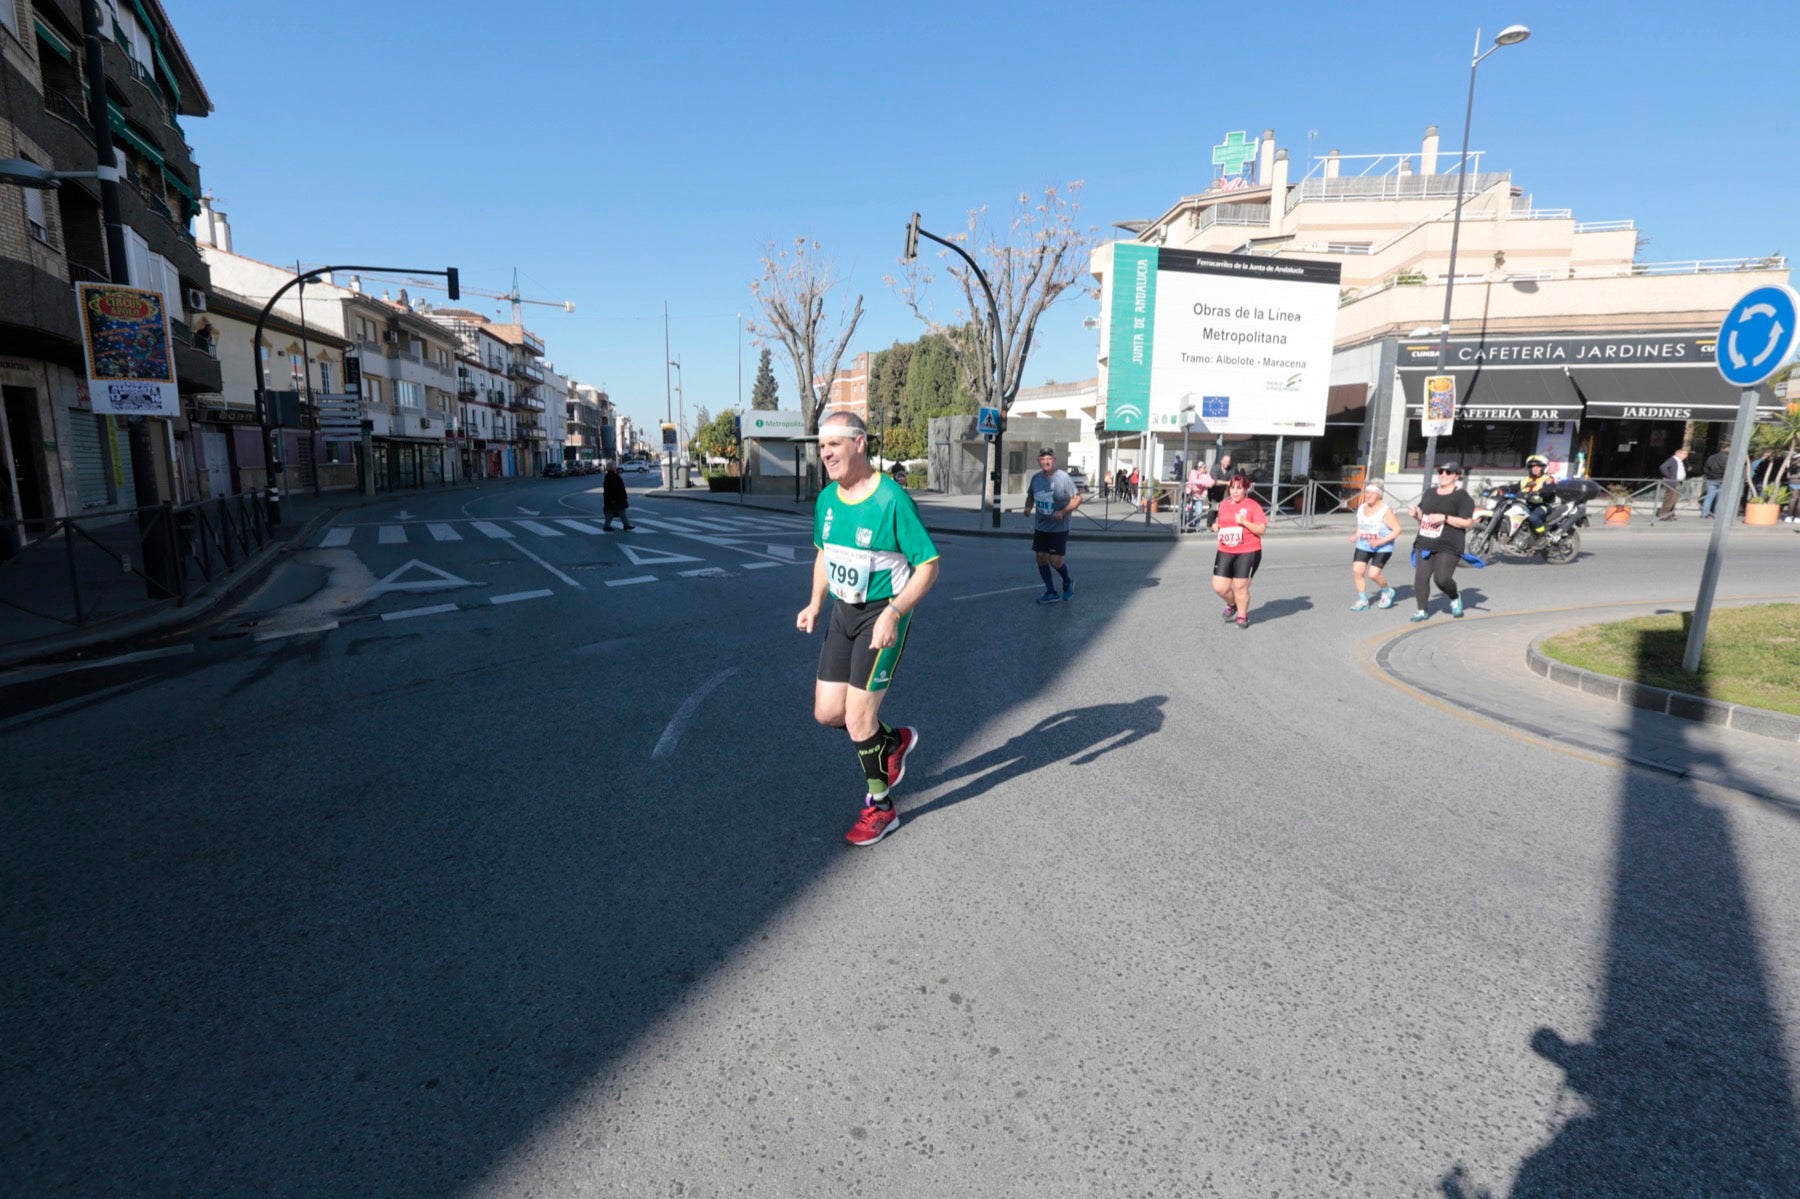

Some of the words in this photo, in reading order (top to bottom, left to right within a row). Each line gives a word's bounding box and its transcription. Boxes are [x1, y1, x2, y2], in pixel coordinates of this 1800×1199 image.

[1196, 258, 1233, 268] Ferrocarriles
[105, 297, 142, 310] CIRCUS
[111, 307, 140, 316] APOLO
[1193, 302, 1231, 318] Obras
[1235, 306, 1250, 319] de
[1254, 307, 1264, 320] la
[1134, 317, 1145, 329] DE
[1202, 328, 1287, 344] Metropolitana
[1132, 334, 1144, 365] JUNTA
[1459, 343, 1566, 360] CAFETERÍA
[1576, 343, 1686, 358] JARDINES
[1181, 352, 1213, 364] Tramo:
[1216, 355, 1254, 366] Albolote
[1263, 357, 1306, 369] Maracena
[1455, 408, 1521, 419] CAFETERÍA
[1532, 410, 1559, 419] BAR
[1622, 407, 1691, 418] JARDINES
[766, 420, 804, 428] Metropolita
[1219, 533, 1241, 542] 2073
[829, 562, 859, 587] 799
